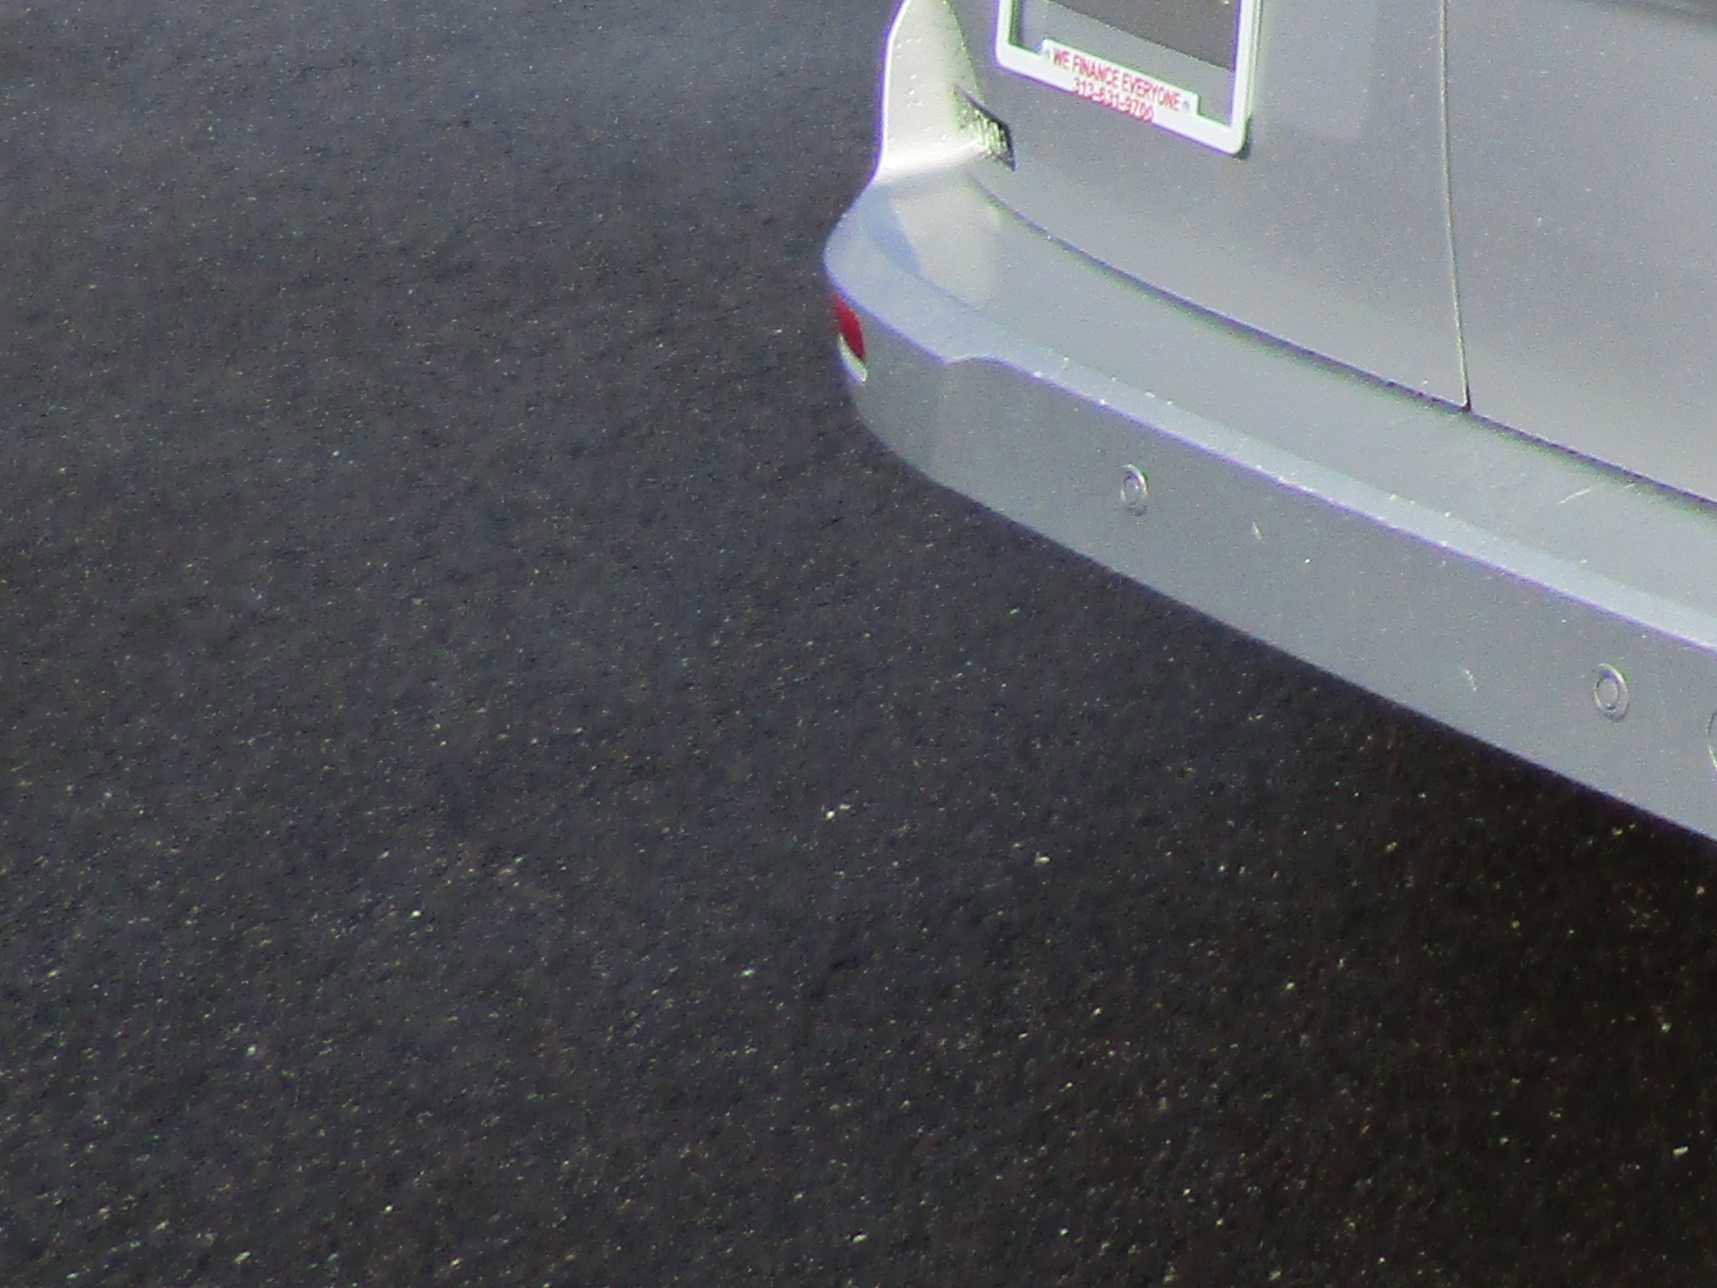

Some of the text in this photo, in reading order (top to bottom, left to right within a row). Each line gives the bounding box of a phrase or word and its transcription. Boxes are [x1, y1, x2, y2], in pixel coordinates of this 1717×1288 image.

[1053, 47, 1182, 111] WE FINANCE EVERYONE
